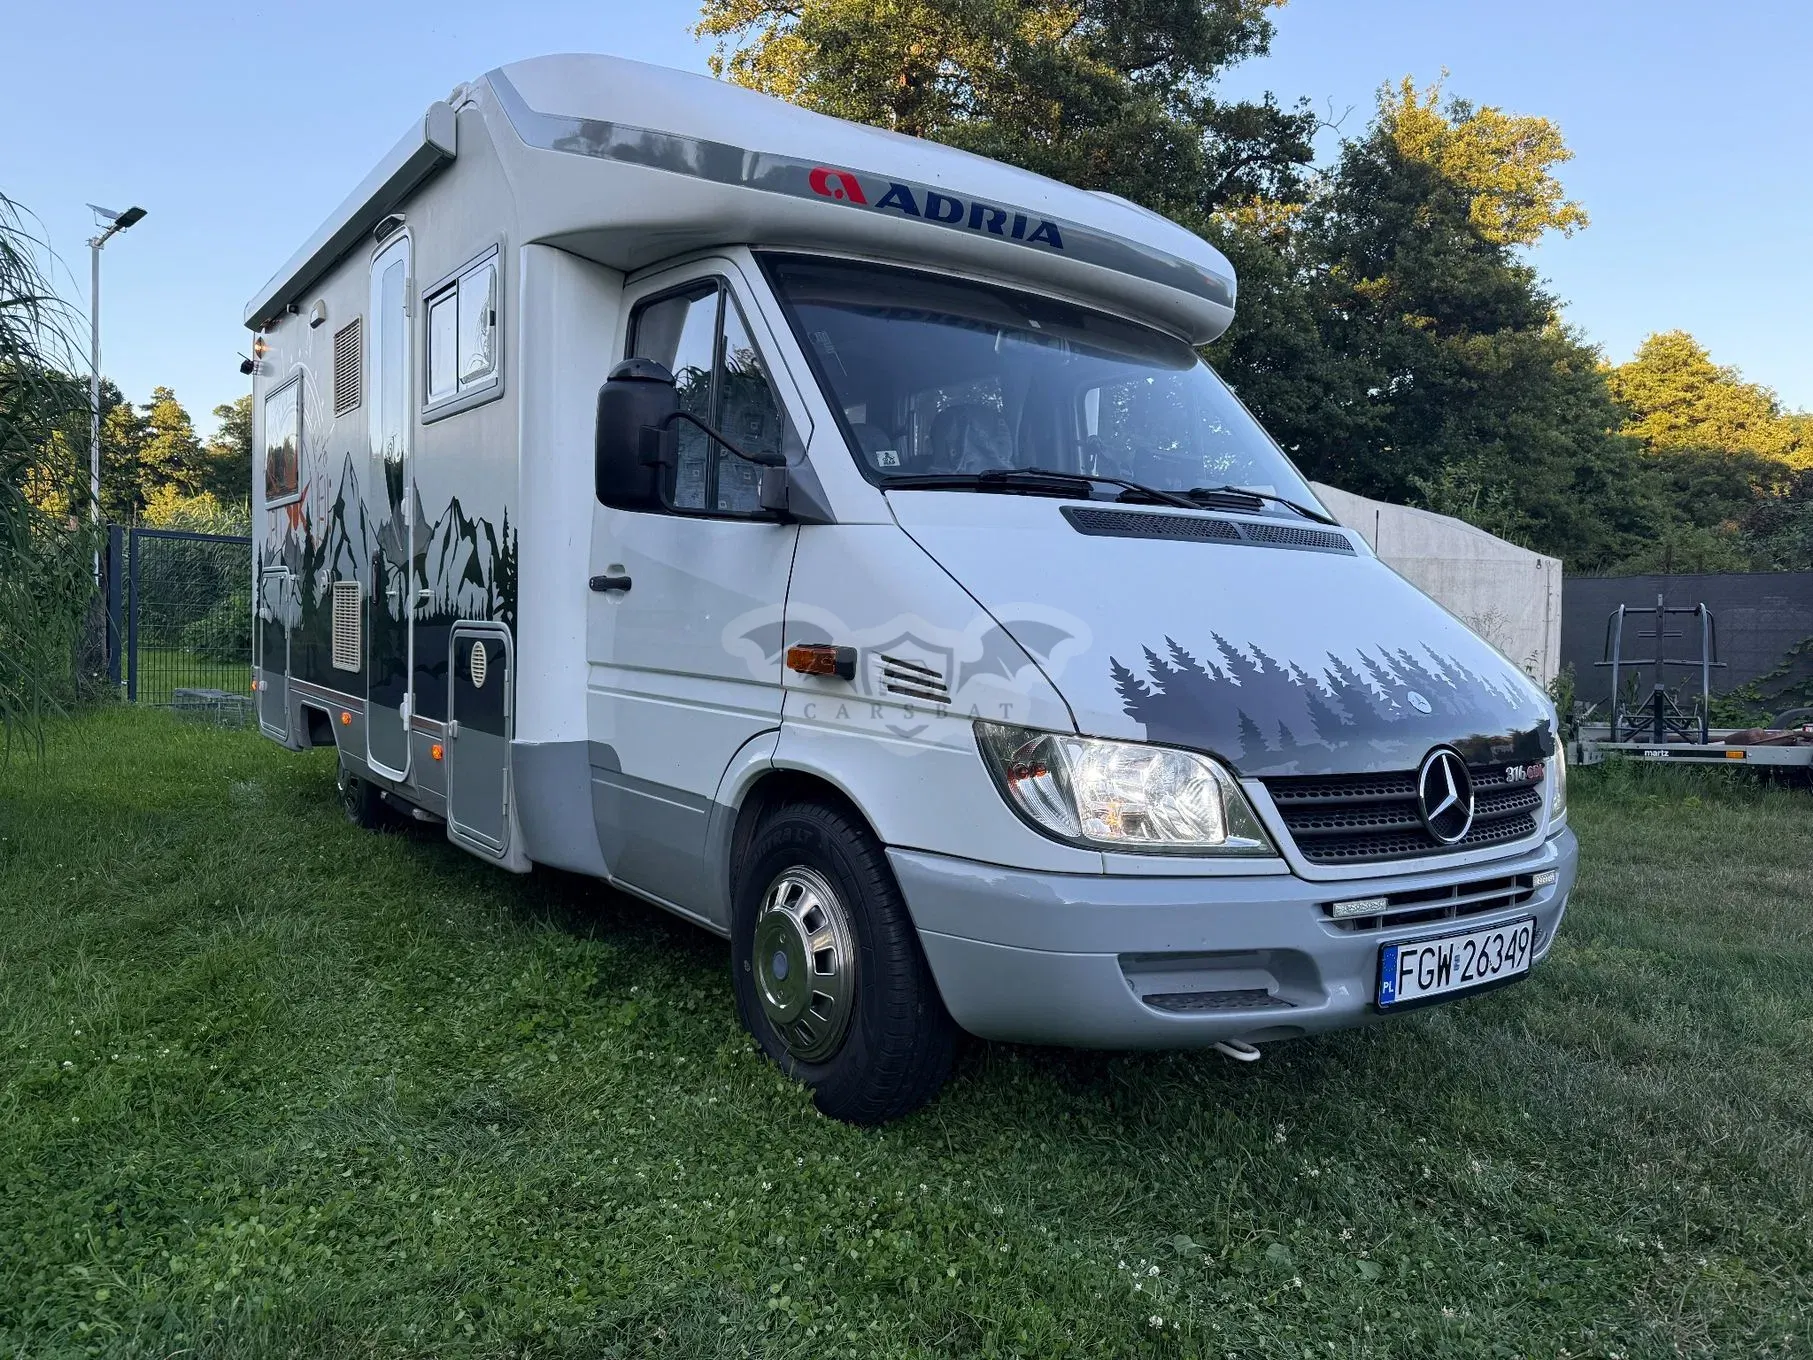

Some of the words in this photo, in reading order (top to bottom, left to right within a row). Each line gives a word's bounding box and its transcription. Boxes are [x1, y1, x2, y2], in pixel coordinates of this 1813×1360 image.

[875, 182, 1064, 249] ADRIA
[1505, 765, 1526, 782] 316
[1399, 943, 1454, 994] FGW
[1460, 926, 1530, 982] 26349
[1382, 981, 1394, 994] PL
